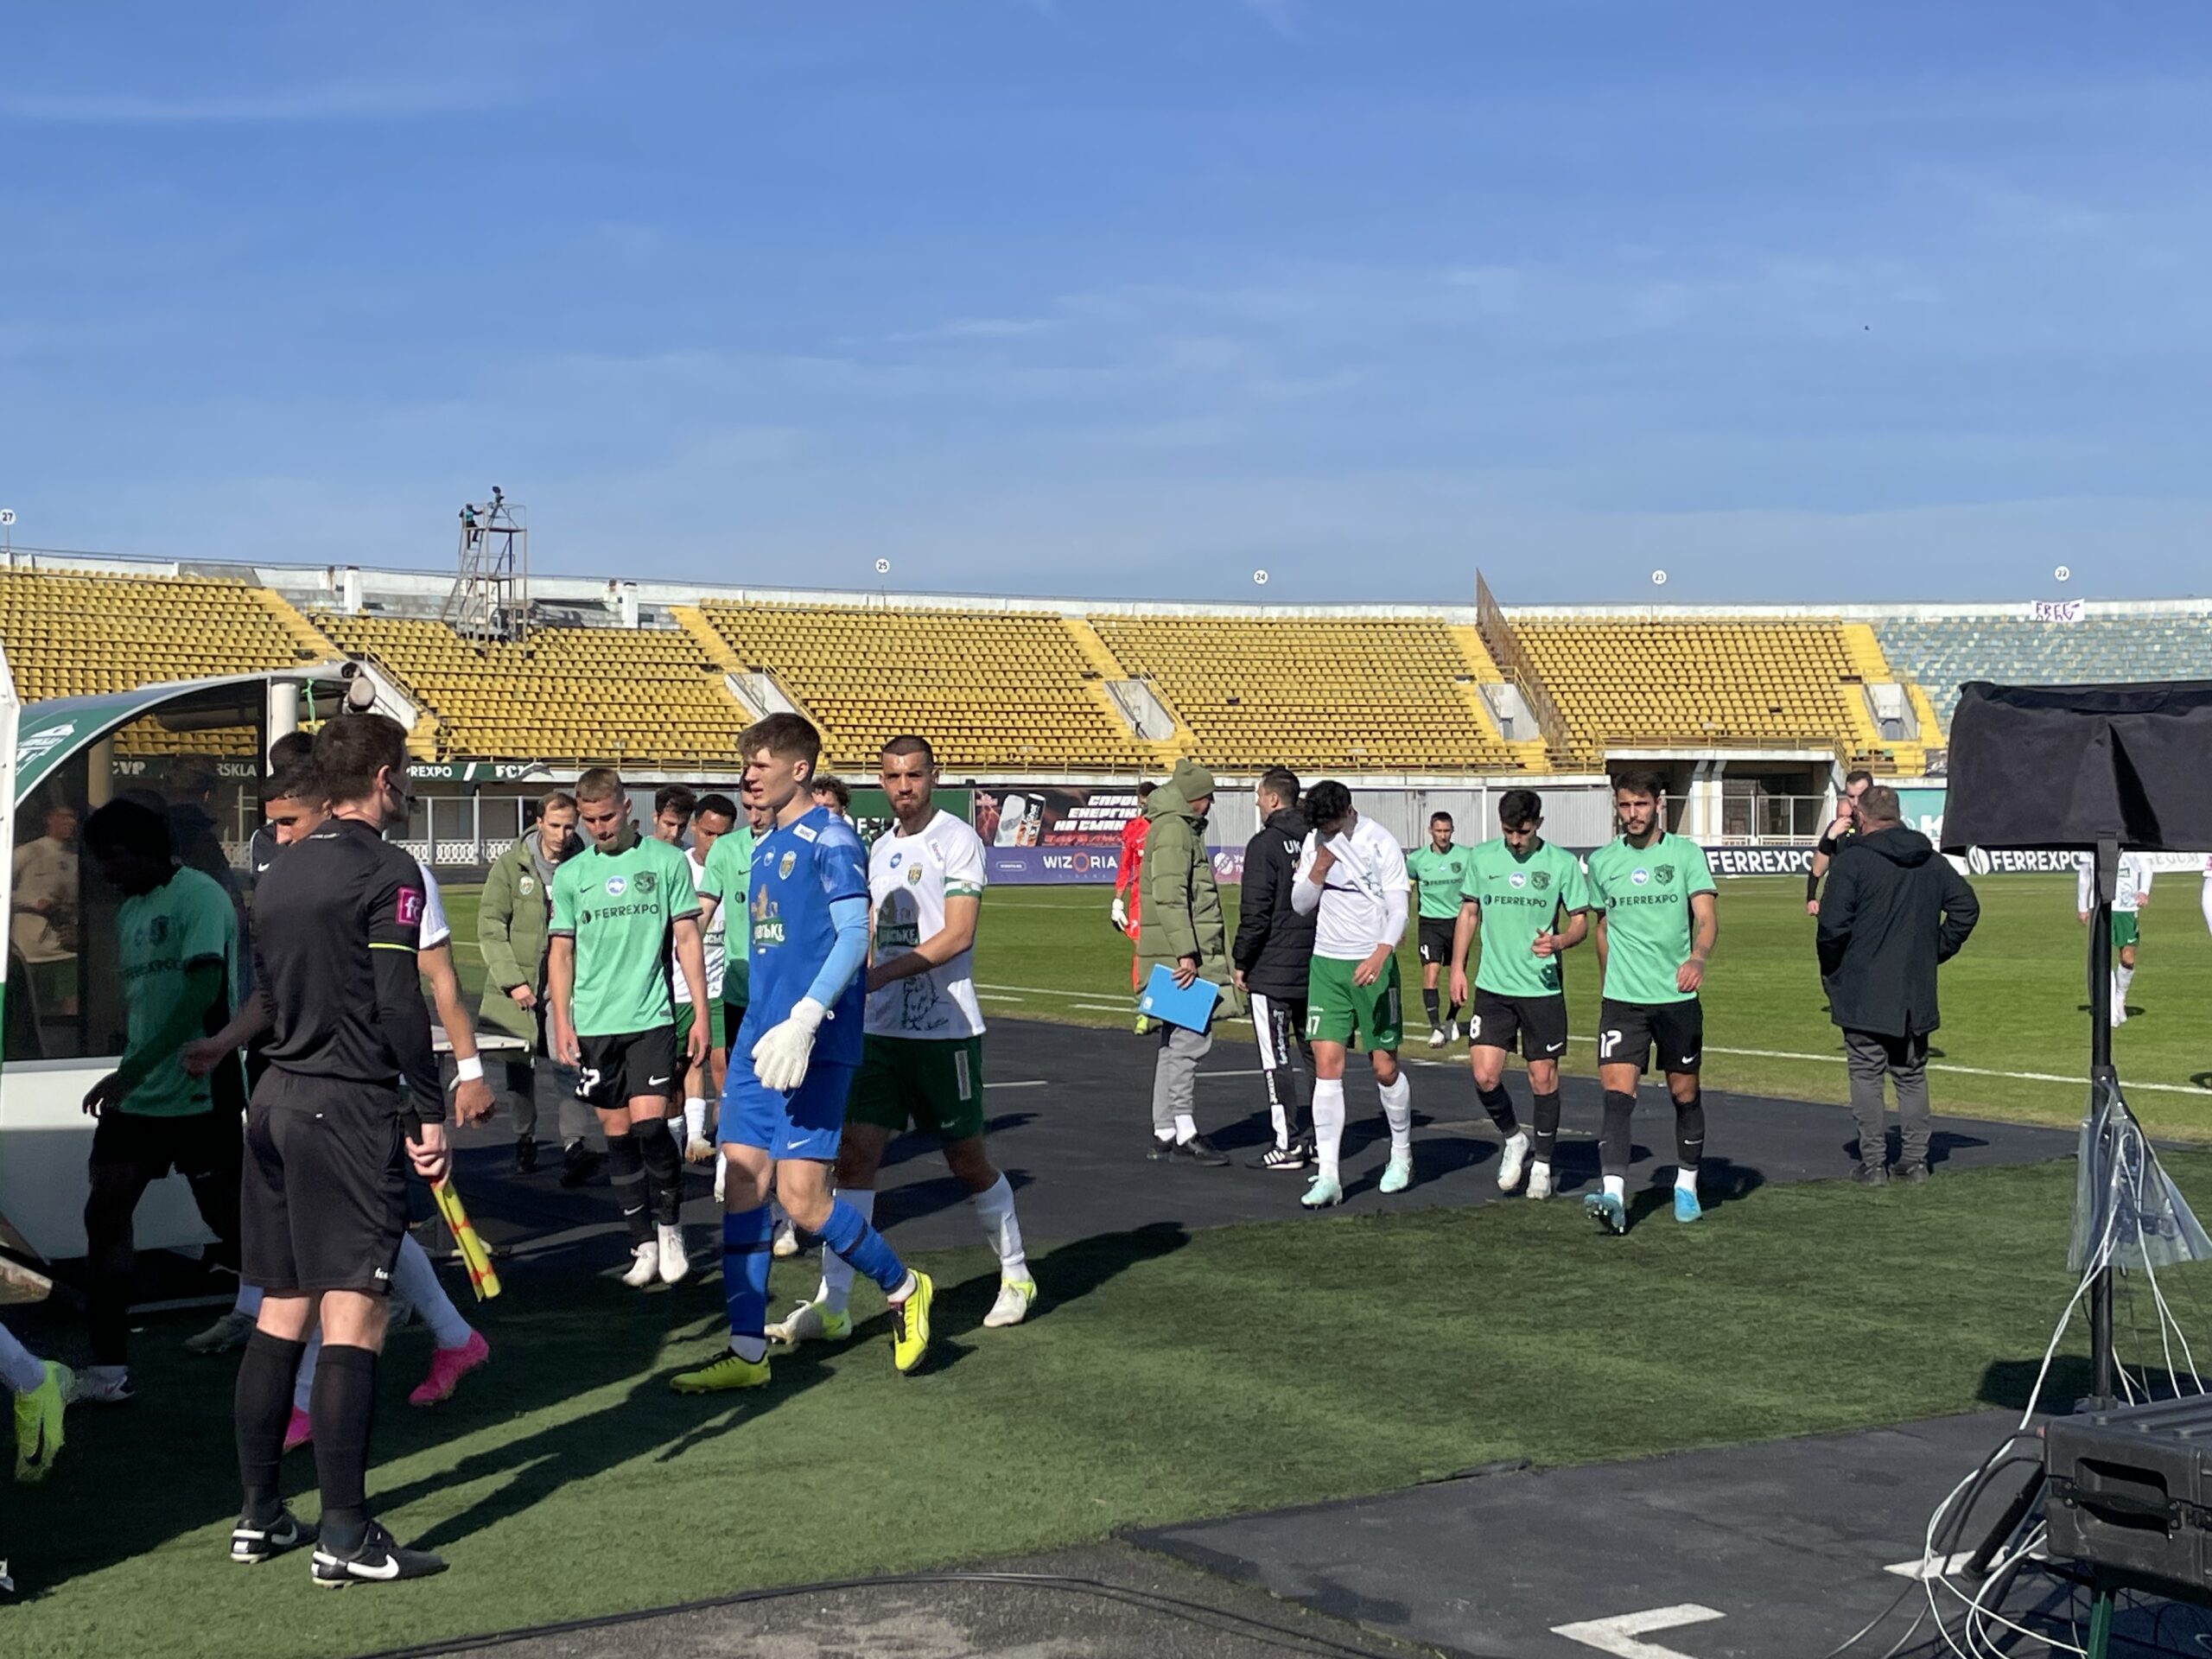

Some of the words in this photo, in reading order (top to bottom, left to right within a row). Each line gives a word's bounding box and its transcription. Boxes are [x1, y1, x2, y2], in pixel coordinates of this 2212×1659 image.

[2, 512, 13, 523] 27
[1043, 853, 1117, 871] WIZORIA
[1494, 895, 1547, 908] FERREXPO
[1618, 894, 1678, 906] FERREXPO
[594, 904, 659, 920] FERREXPO
[1420, 944, 1430, 960] 4
[1469, 1014, 1482, 1039] 8
[1599, 1029, 1622, 1058] 17
